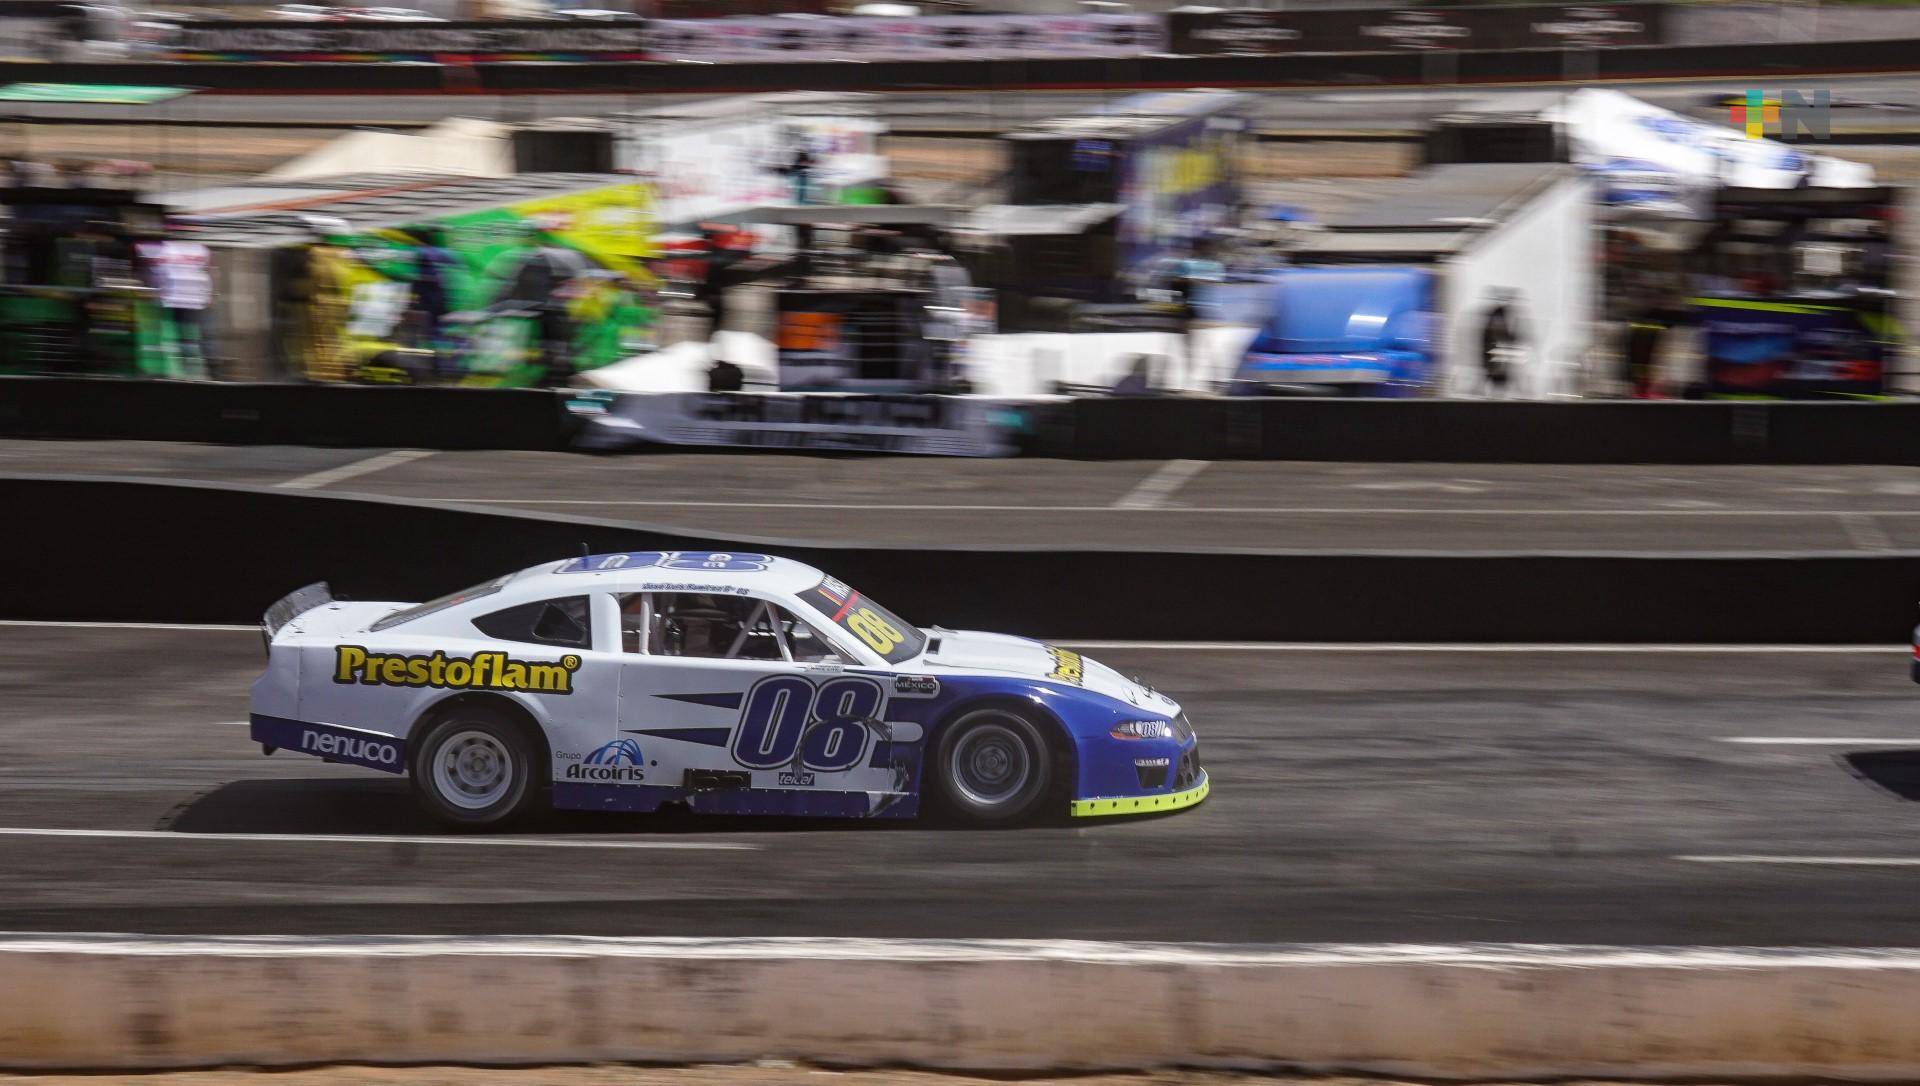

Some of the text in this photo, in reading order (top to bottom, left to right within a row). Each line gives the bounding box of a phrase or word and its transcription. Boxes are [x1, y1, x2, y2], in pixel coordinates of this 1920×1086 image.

[846, 607, 905, 655] 08
[731, 673, 883, 772] 08
[301, 730, 397, 764] nenuco
[556, 751, 582, 761] Grupo
[566, 763, 644, 781] Arcoiris
